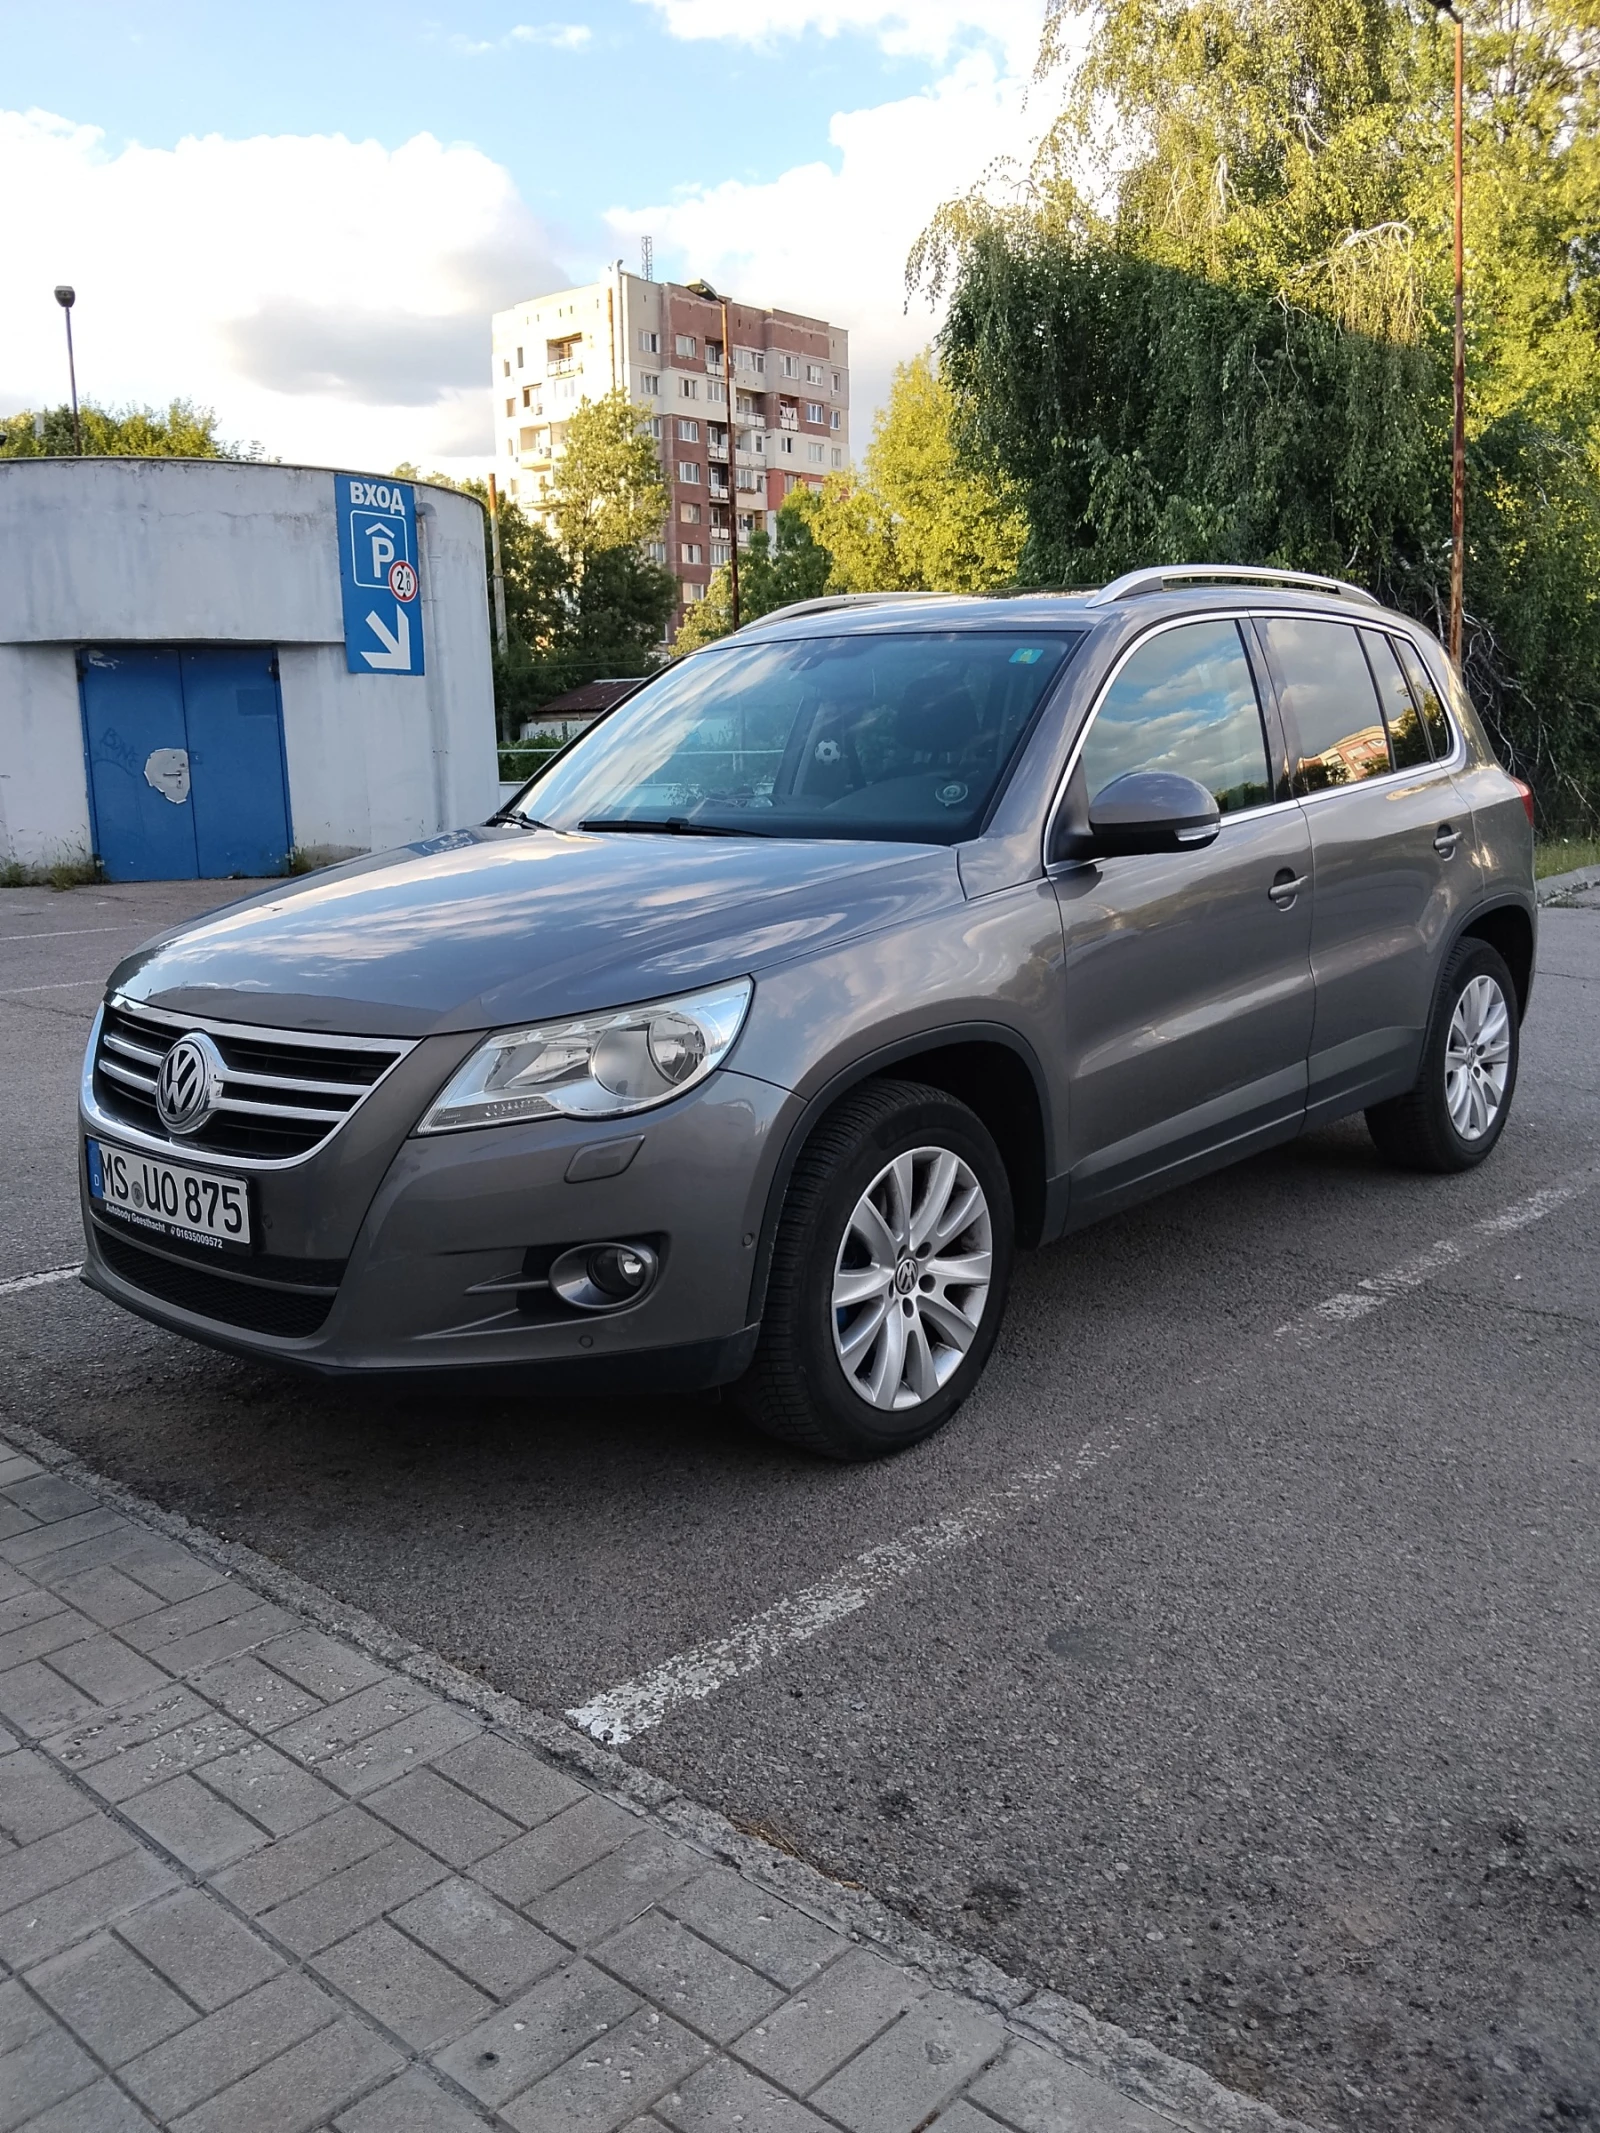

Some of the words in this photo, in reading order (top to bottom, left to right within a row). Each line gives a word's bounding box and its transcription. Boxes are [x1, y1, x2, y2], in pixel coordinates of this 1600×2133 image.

[350, 481, 405, 516] ВХОД
[372, 536, 395, 578] P
[94, 1174, 100, 1186] D
[99, 1149, 129, 1200] MS
[143, 1164, 179, 1217] UO
[184, 1177, 242, 1233] 875
[131, 1212, 166, 1233] Geesthacht
